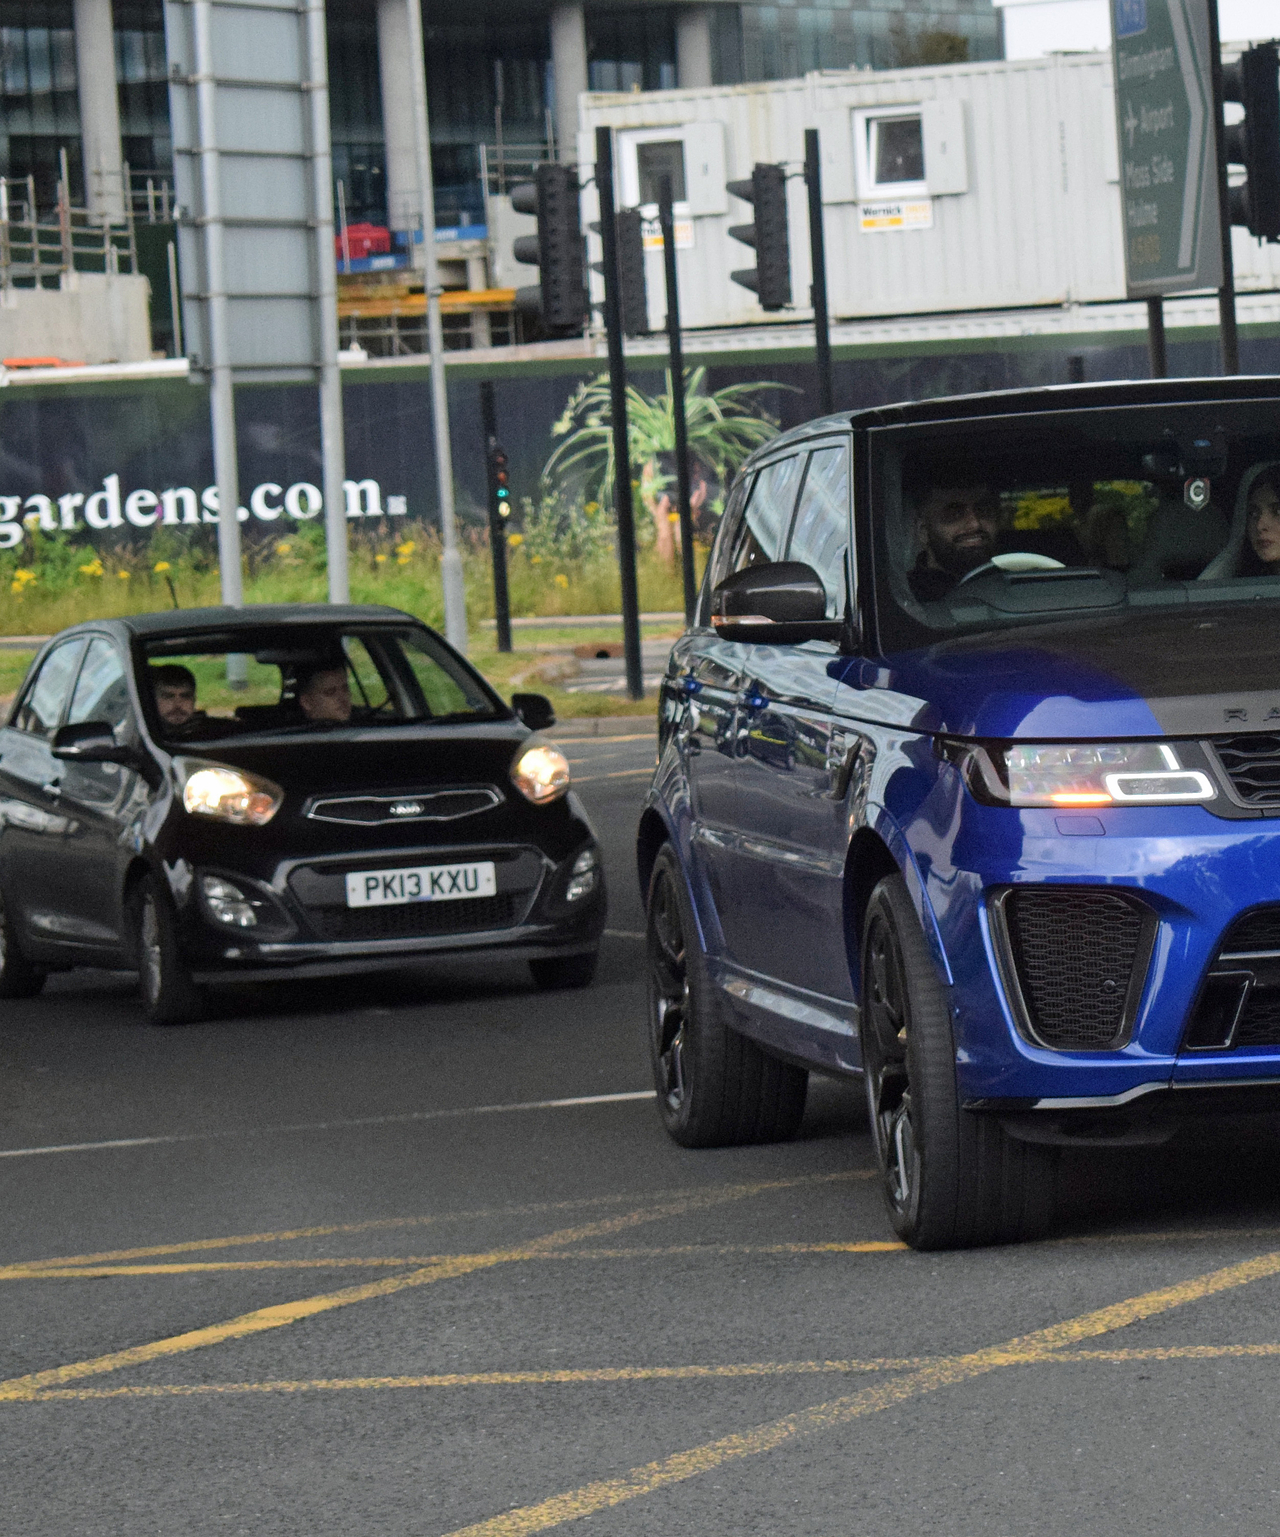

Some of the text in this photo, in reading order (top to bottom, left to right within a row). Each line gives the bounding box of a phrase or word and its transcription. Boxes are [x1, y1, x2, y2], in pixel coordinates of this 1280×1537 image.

[1140, 100, 1174, 137] Airport
[364, 867, 479, 901] PK13 KXU
